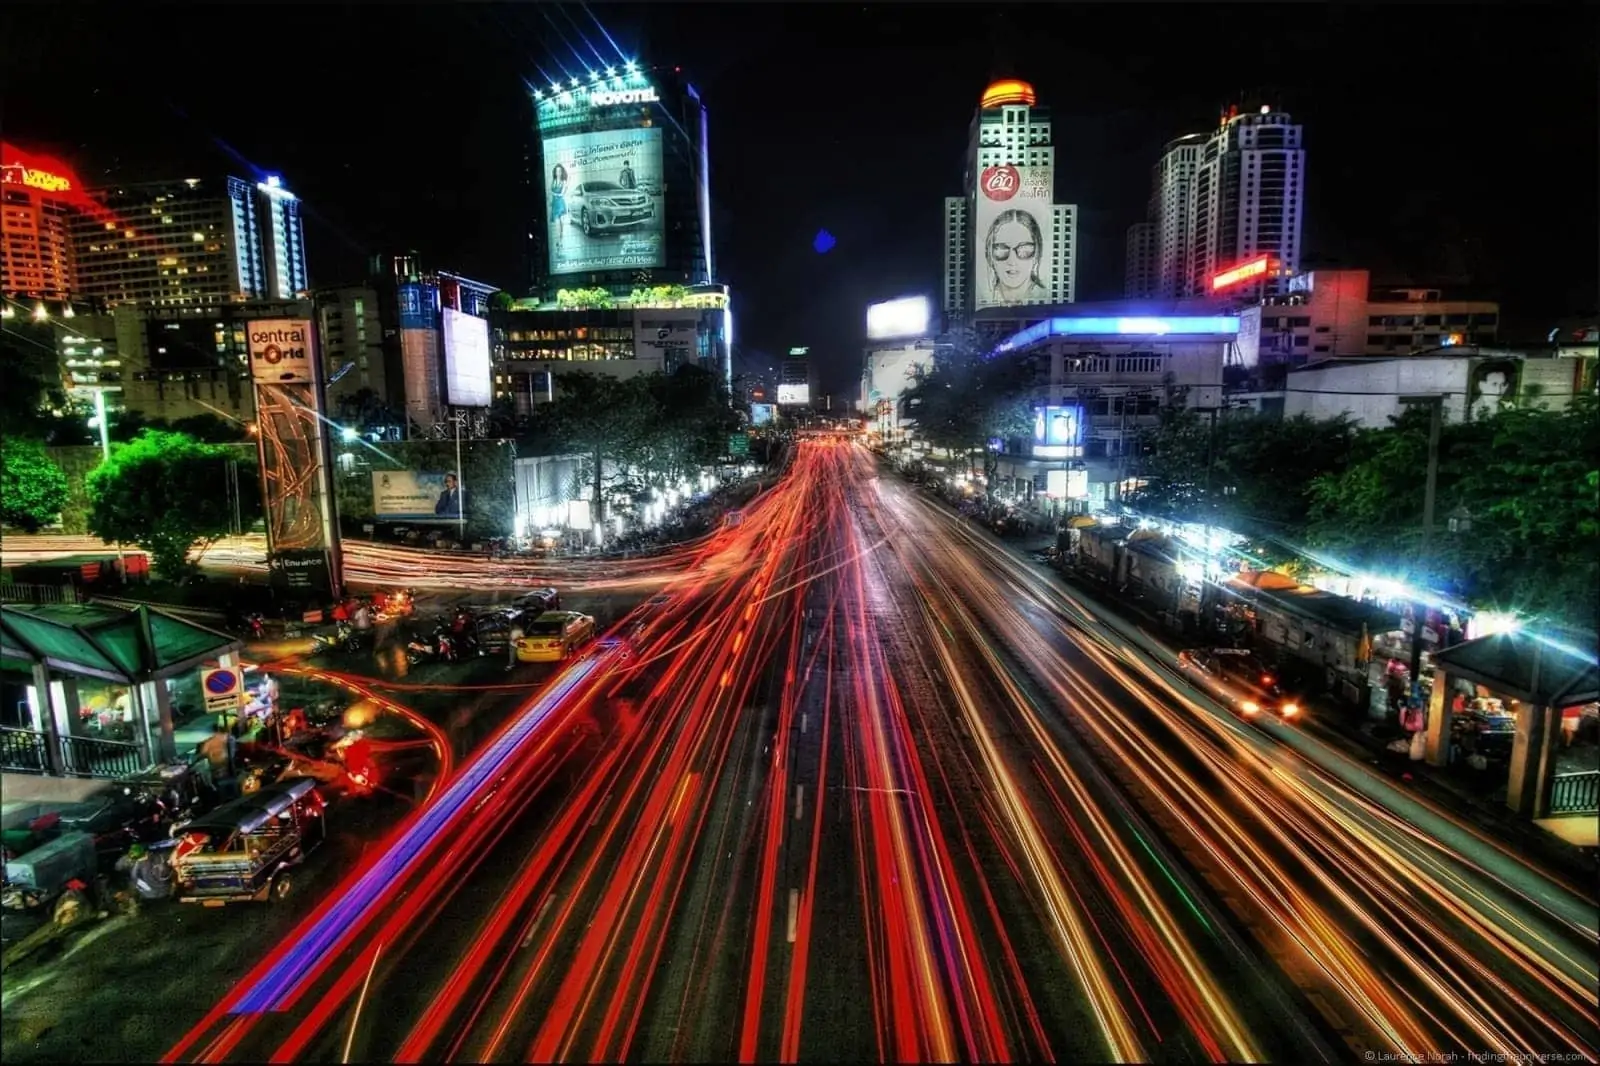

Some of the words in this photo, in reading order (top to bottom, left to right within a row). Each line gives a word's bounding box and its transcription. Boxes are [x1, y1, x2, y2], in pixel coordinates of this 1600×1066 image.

[591, 86, 660, 107] NOVOTEL
[252, 328, 304, 343] central
[253, 344, 304, 364] world
